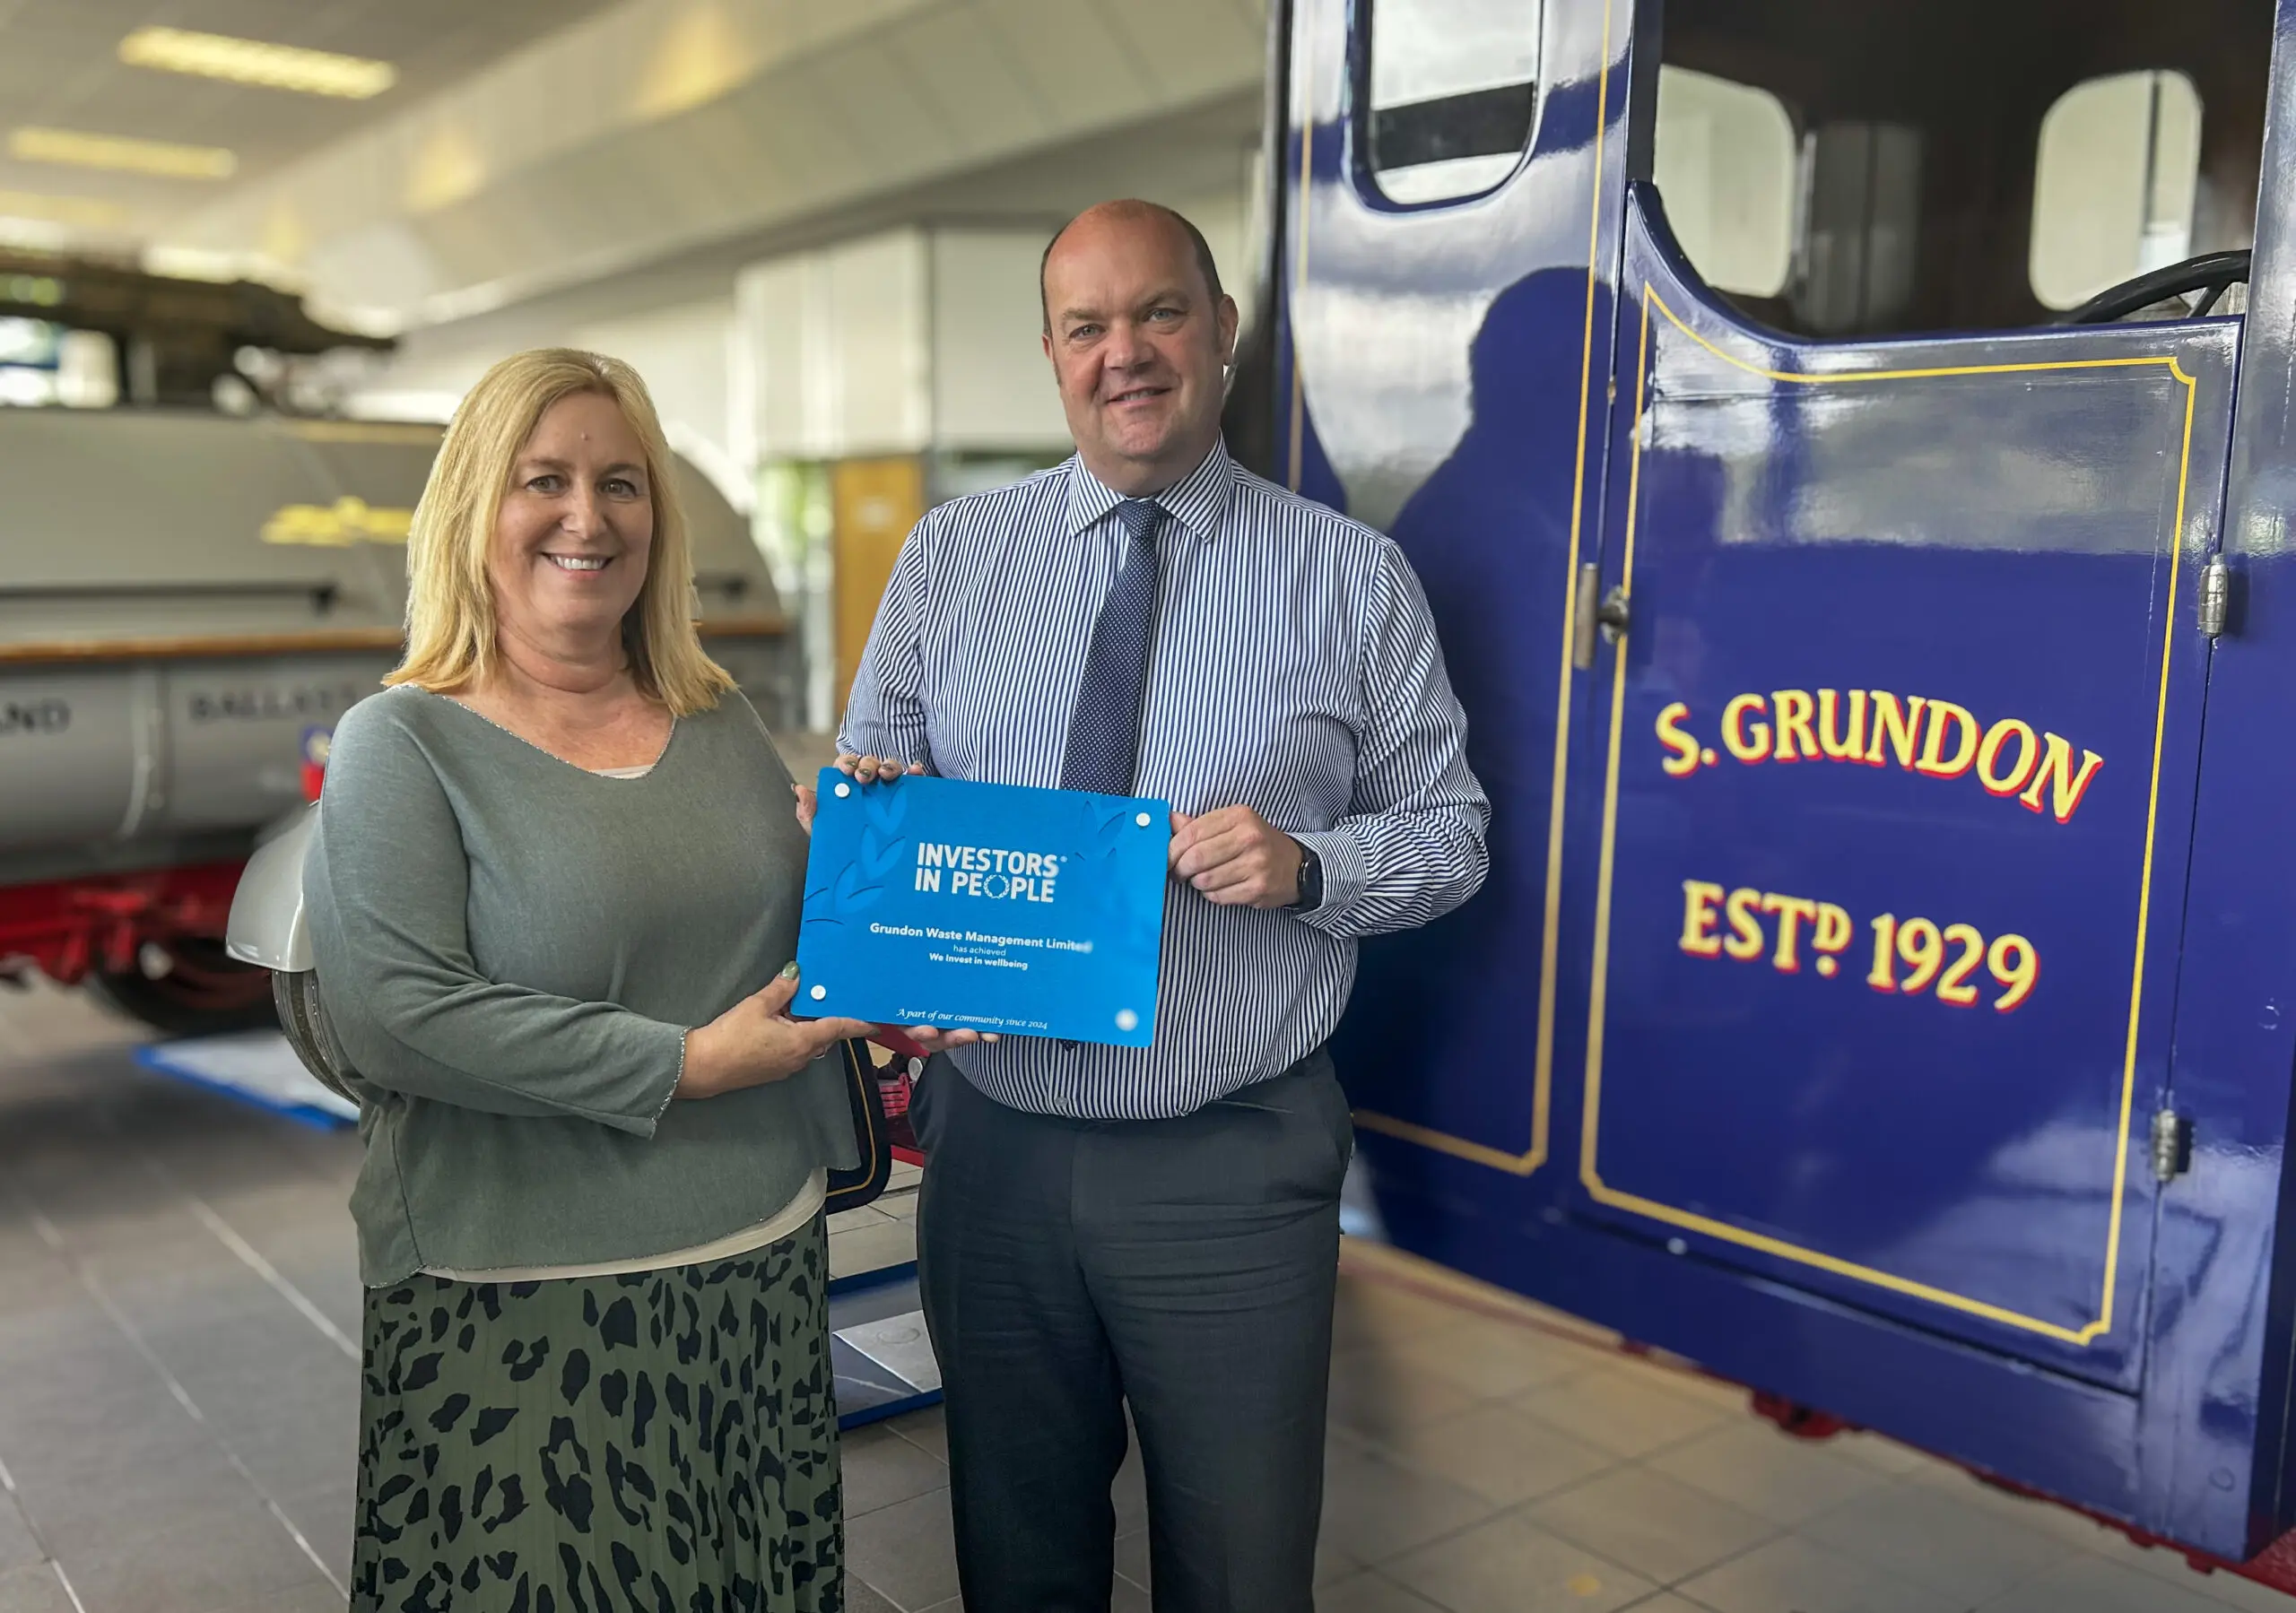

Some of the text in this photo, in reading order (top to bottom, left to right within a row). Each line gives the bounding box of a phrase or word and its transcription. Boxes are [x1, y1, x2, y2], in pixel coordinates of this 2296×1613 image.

[1656, 688, 2103, 824] S. GRUNDON
[915, 867, 942, 893] IN
[869, 922, 924, 938] Grundon
[926, 926, 963, 941] Waste
[964, 930, 1044, 949] Management
[929, 952, 1029, 971] We Invest in wellbeing
[952, 944, 1007, 957] has achieved
[1867, 912, 2041, 1013] 1929
[896, 1008, 906, 1018] A
[904, 1010, 926, 1020] part
[927, 1010, 939, 1021] of
[953, 1015, 1004, 1028] community
[1004, 1019, 1027, 1028] since
[1028, 1020, 1048, 1030] 2024
